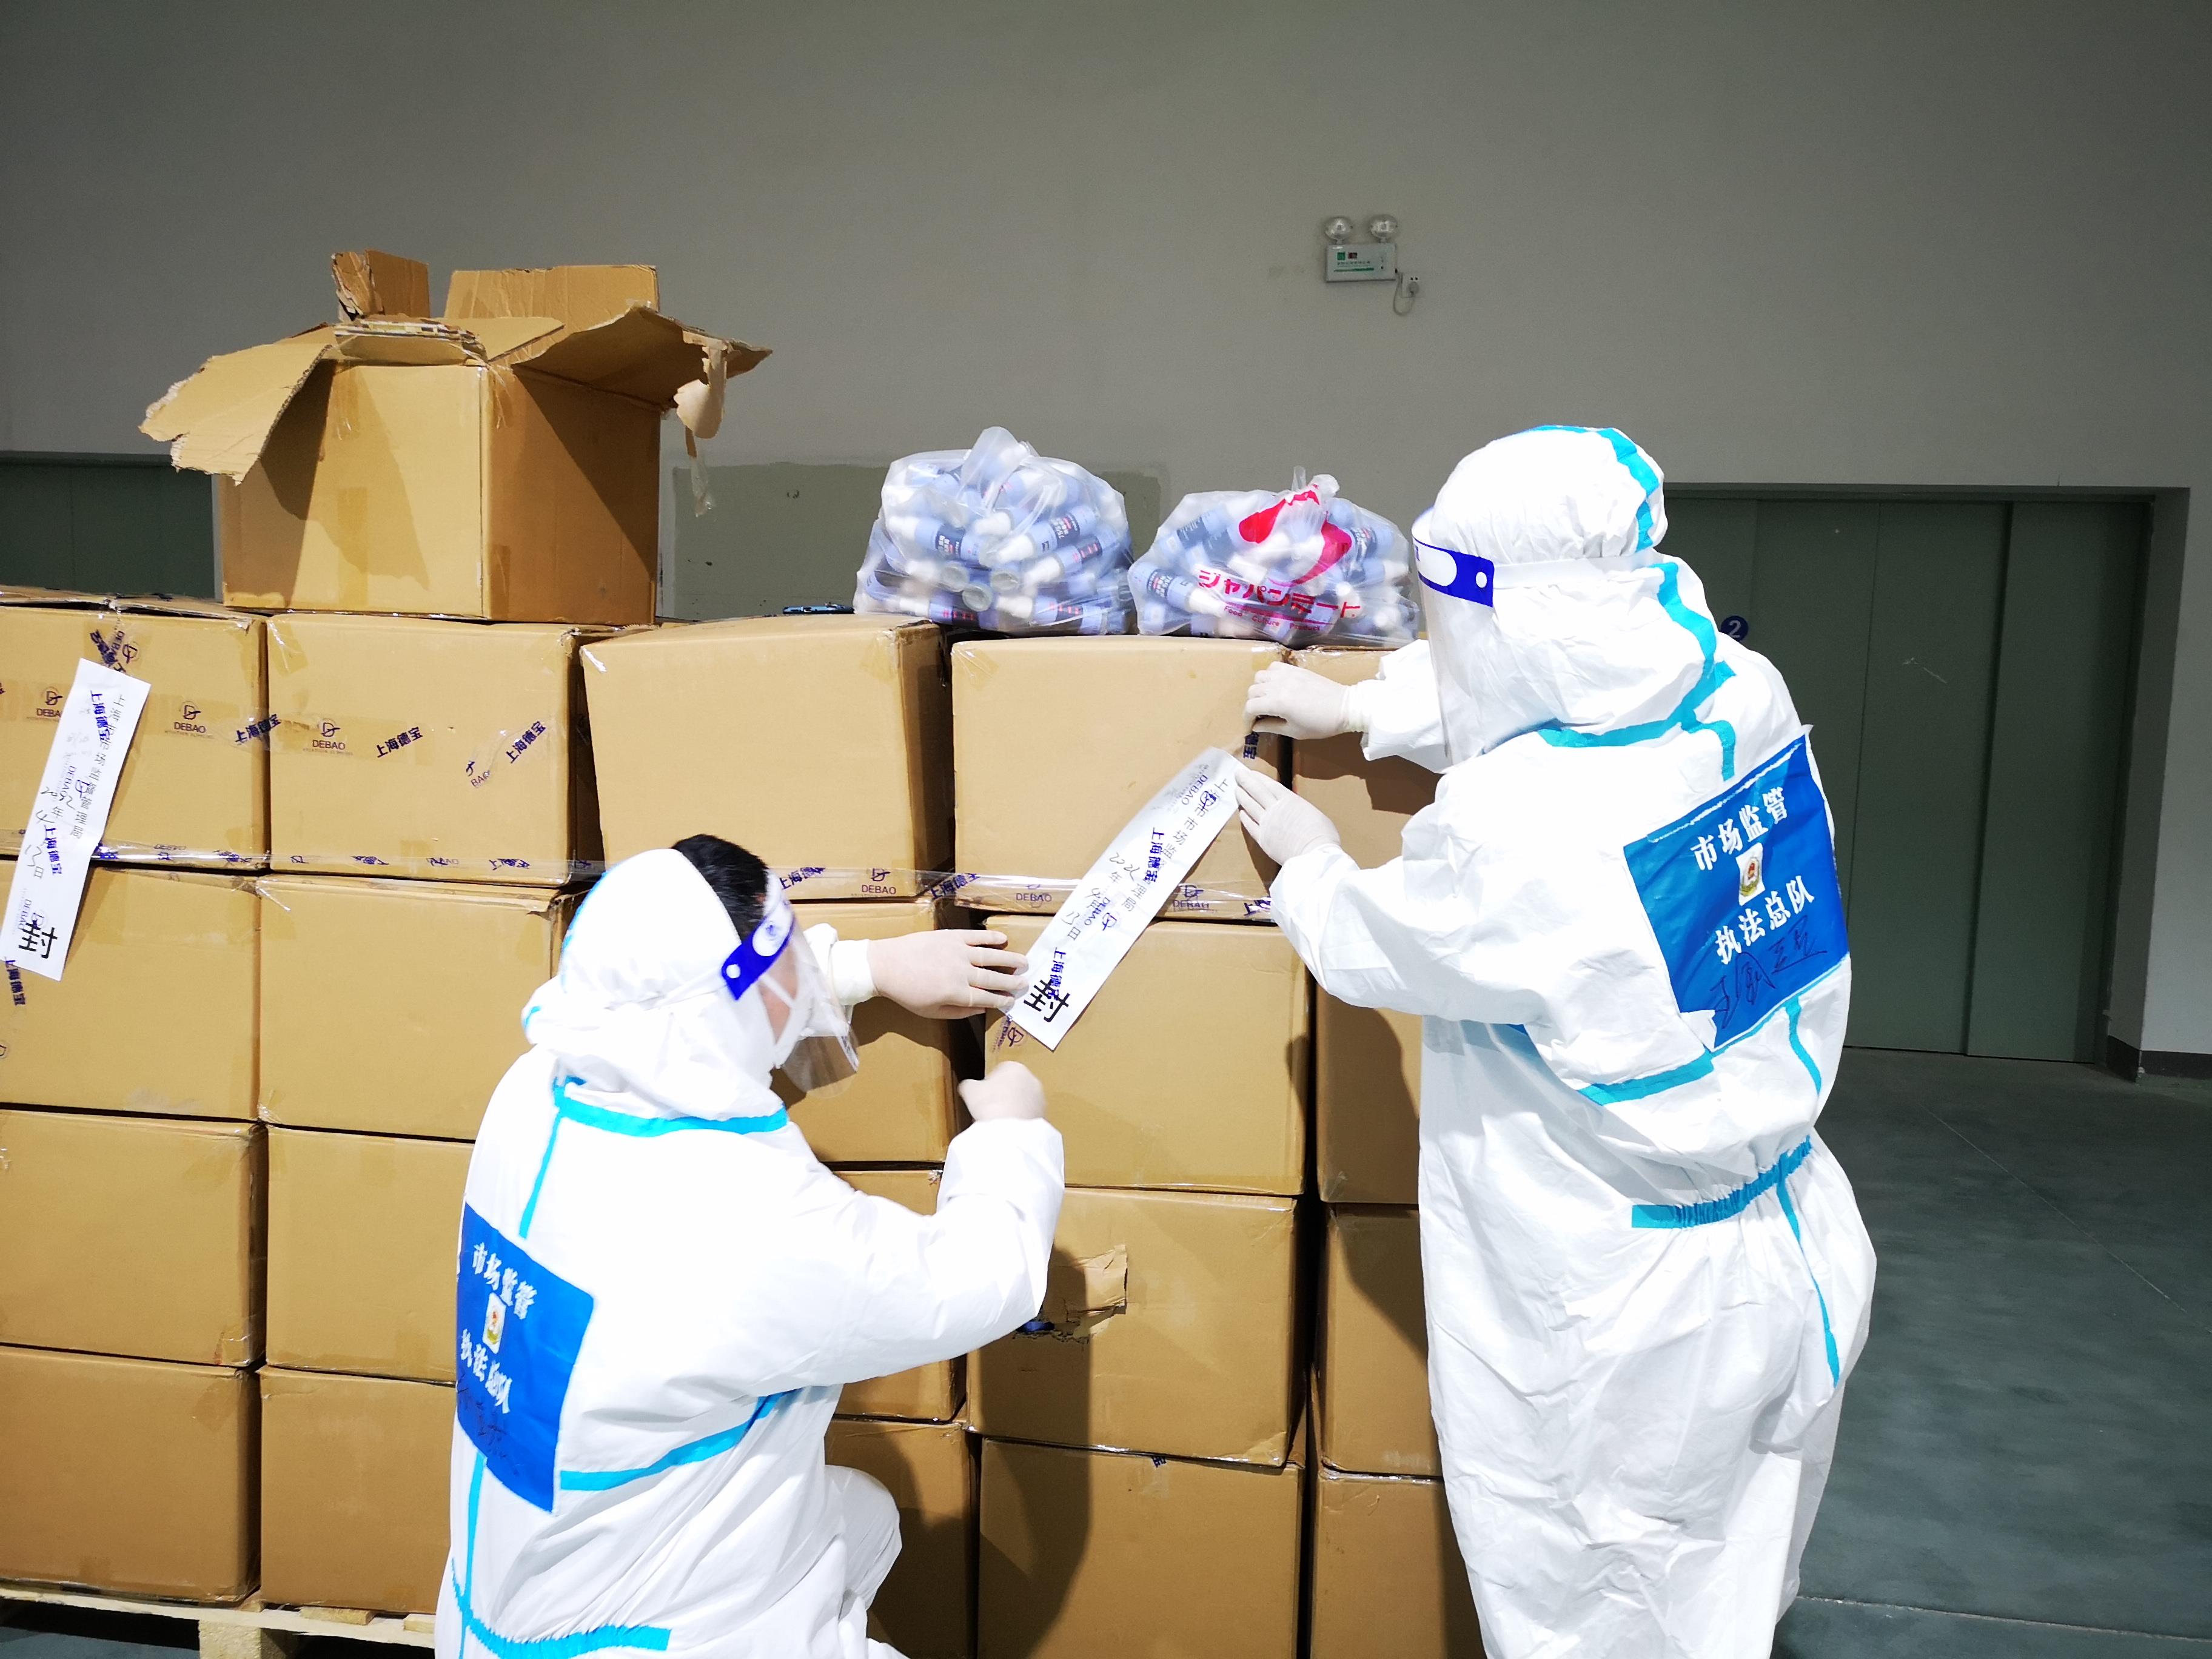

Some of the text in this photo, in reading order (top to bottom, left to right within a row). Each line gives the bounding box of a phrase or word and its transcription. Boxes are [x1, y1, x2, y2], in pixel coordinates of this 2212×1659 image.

[1224, 606, 1243, 617] Food
[1252, 615, 1280, 627] Culture
[1728, 620, 1741, 638] 2
[36, 708, 61, 718] DEBA
[174, 722, 206, 734] DEBAO
[235, 714, 282, 746] 上海德宝
[312, 739, 346, 751] DEBAO
[375, 726, 423, 759] 上海德宝
[504, 721, 546, 763] 上海德宝
[1181, 774, 1208, 806] DEBAO
[1690, 786, 1789, 871] 市场监管
[862, 884, 897, 895] DEBAO
[1016, 893, 1053, 902] DEBAO
[1715, 875, 1815, 965] 执法总队
[18, 919, 58, 959] 封
[1024, 979, 1071, 1023] 封
[473, 1242, 538, 1320] 市场监管
